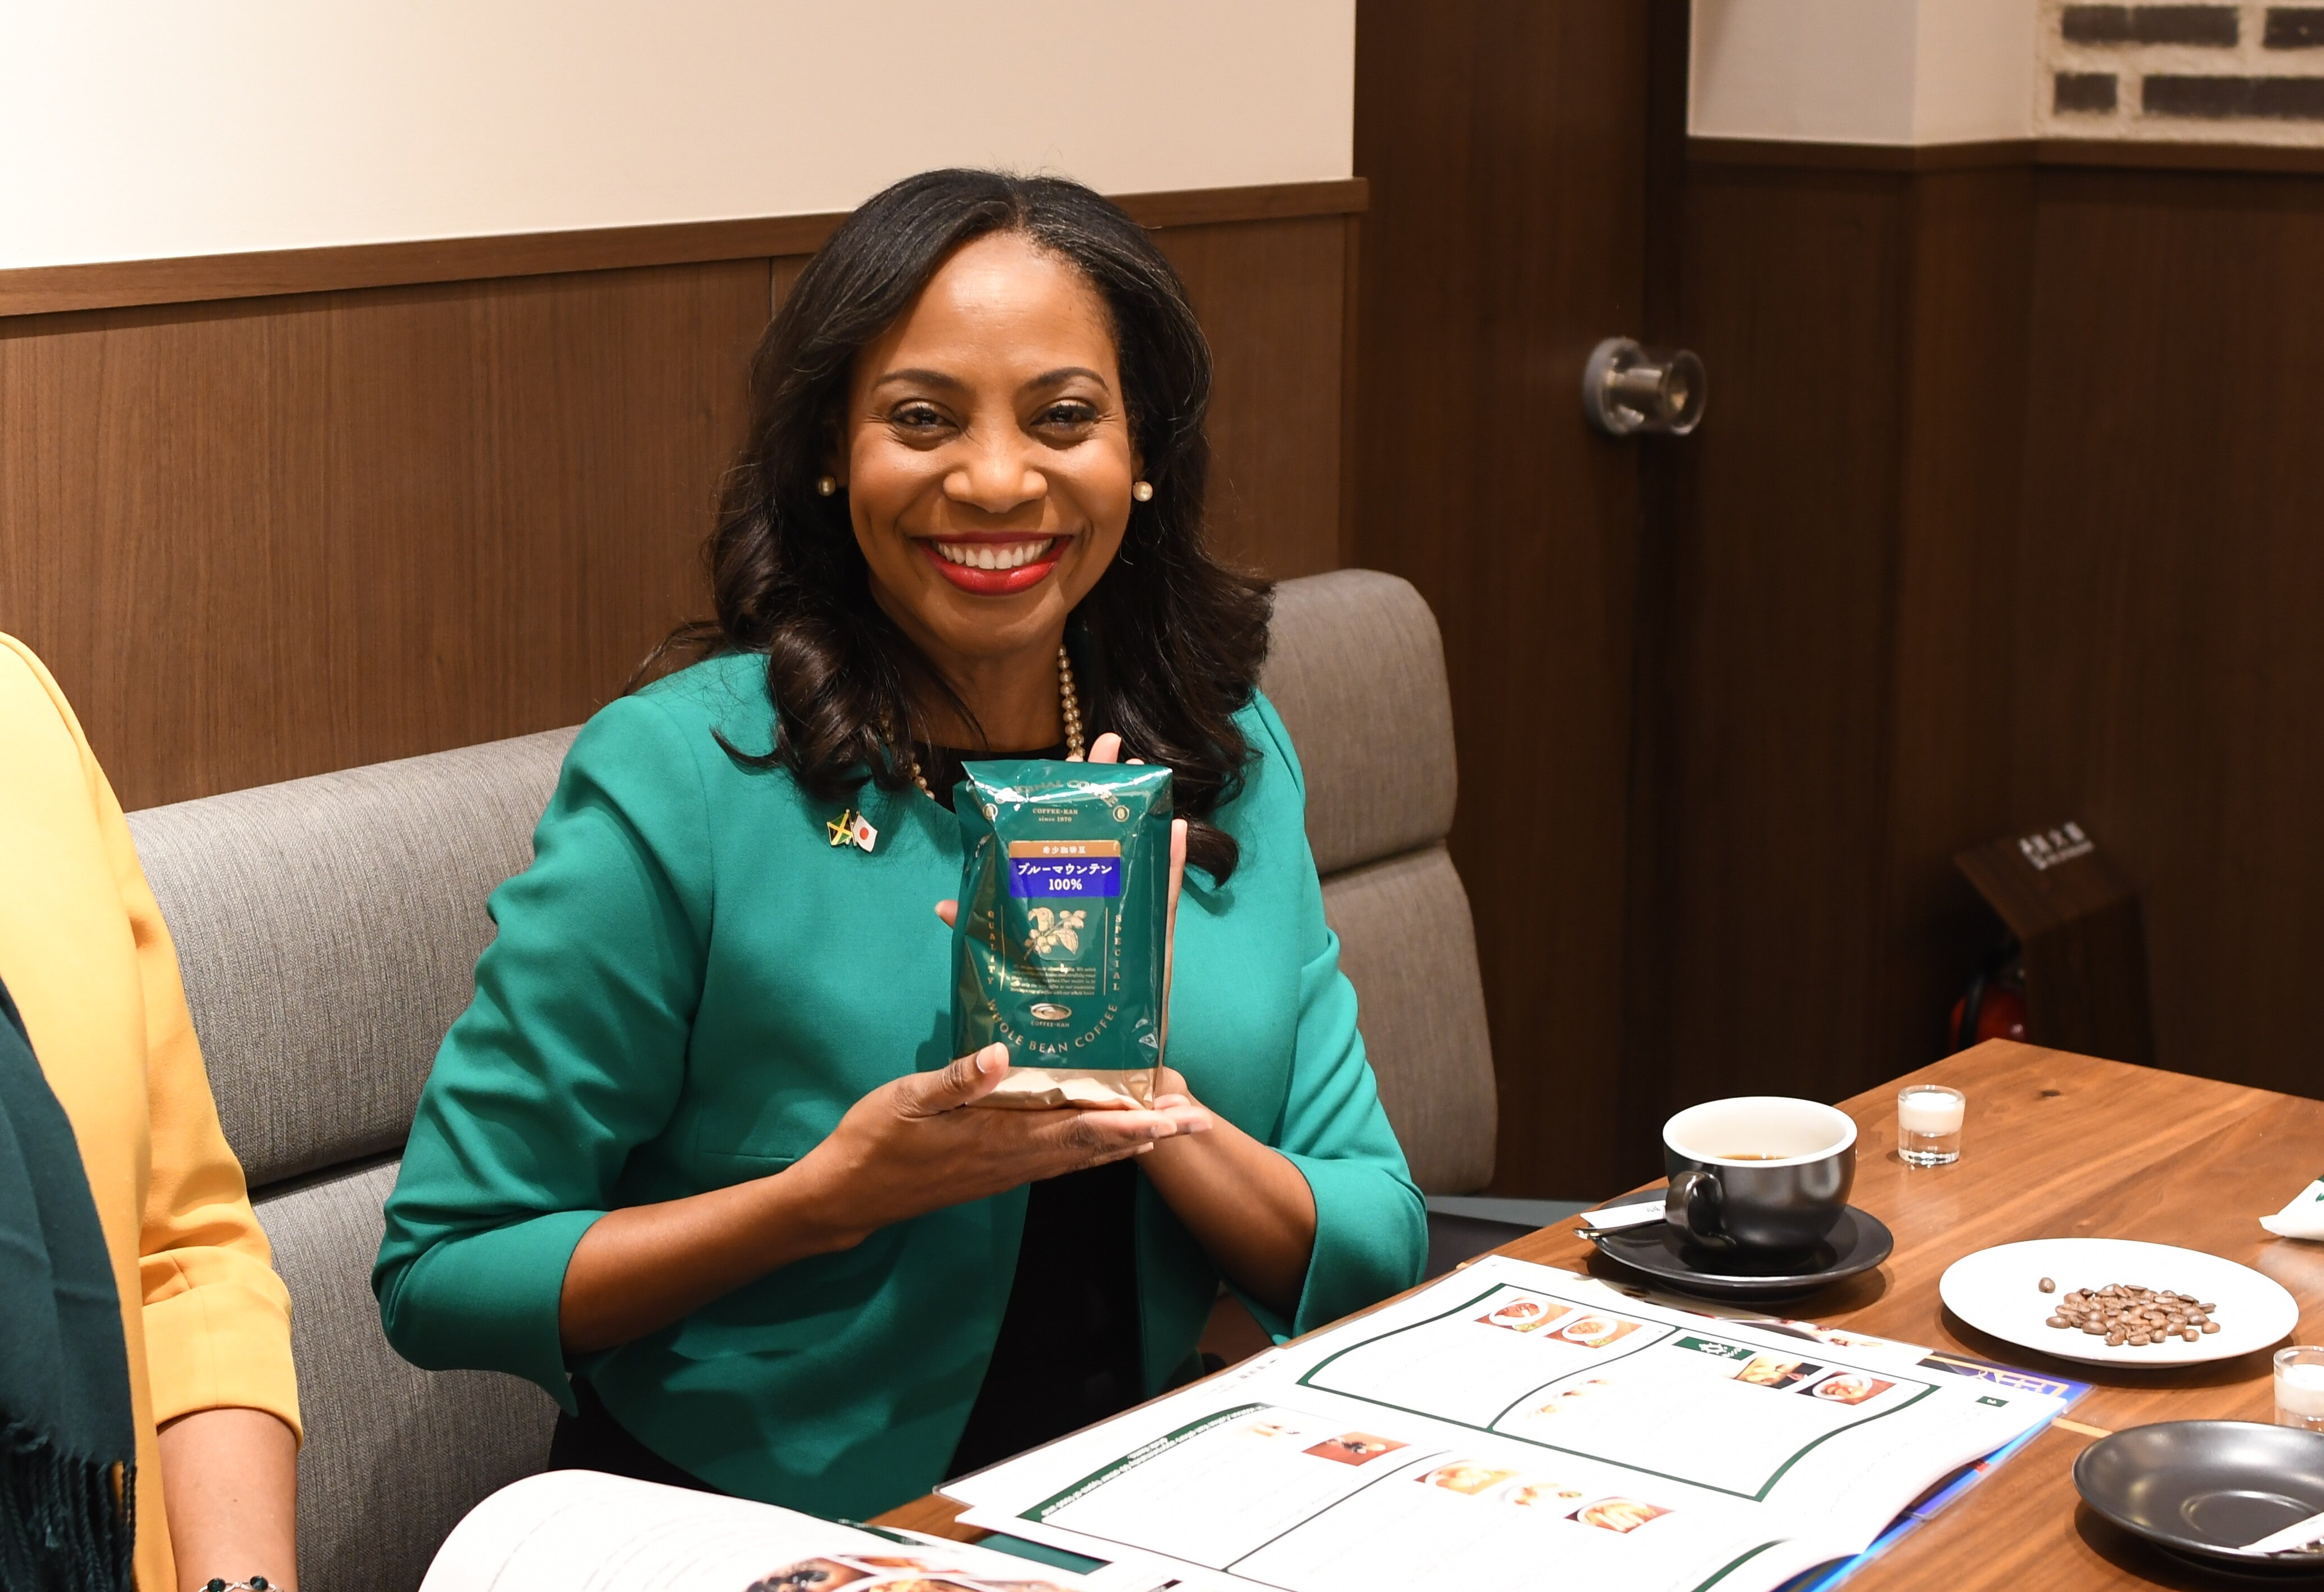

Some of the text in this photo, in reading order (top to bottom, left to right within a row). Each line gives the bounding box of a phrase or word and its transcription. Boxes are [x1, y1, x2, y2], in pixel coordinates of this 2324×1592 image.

[1043, 845, 1086, 854] 希少珈琲豆
[1018, 862, 1112, 875] ブルーマウンテン
[1048, 878, 1082, 890] 100%
[1113, 914, 1122, 991] SPECIAL
[1029, 1041, 1068, 1054] BEAN
[1075, 1003, 1118, 1048] COFFEE
